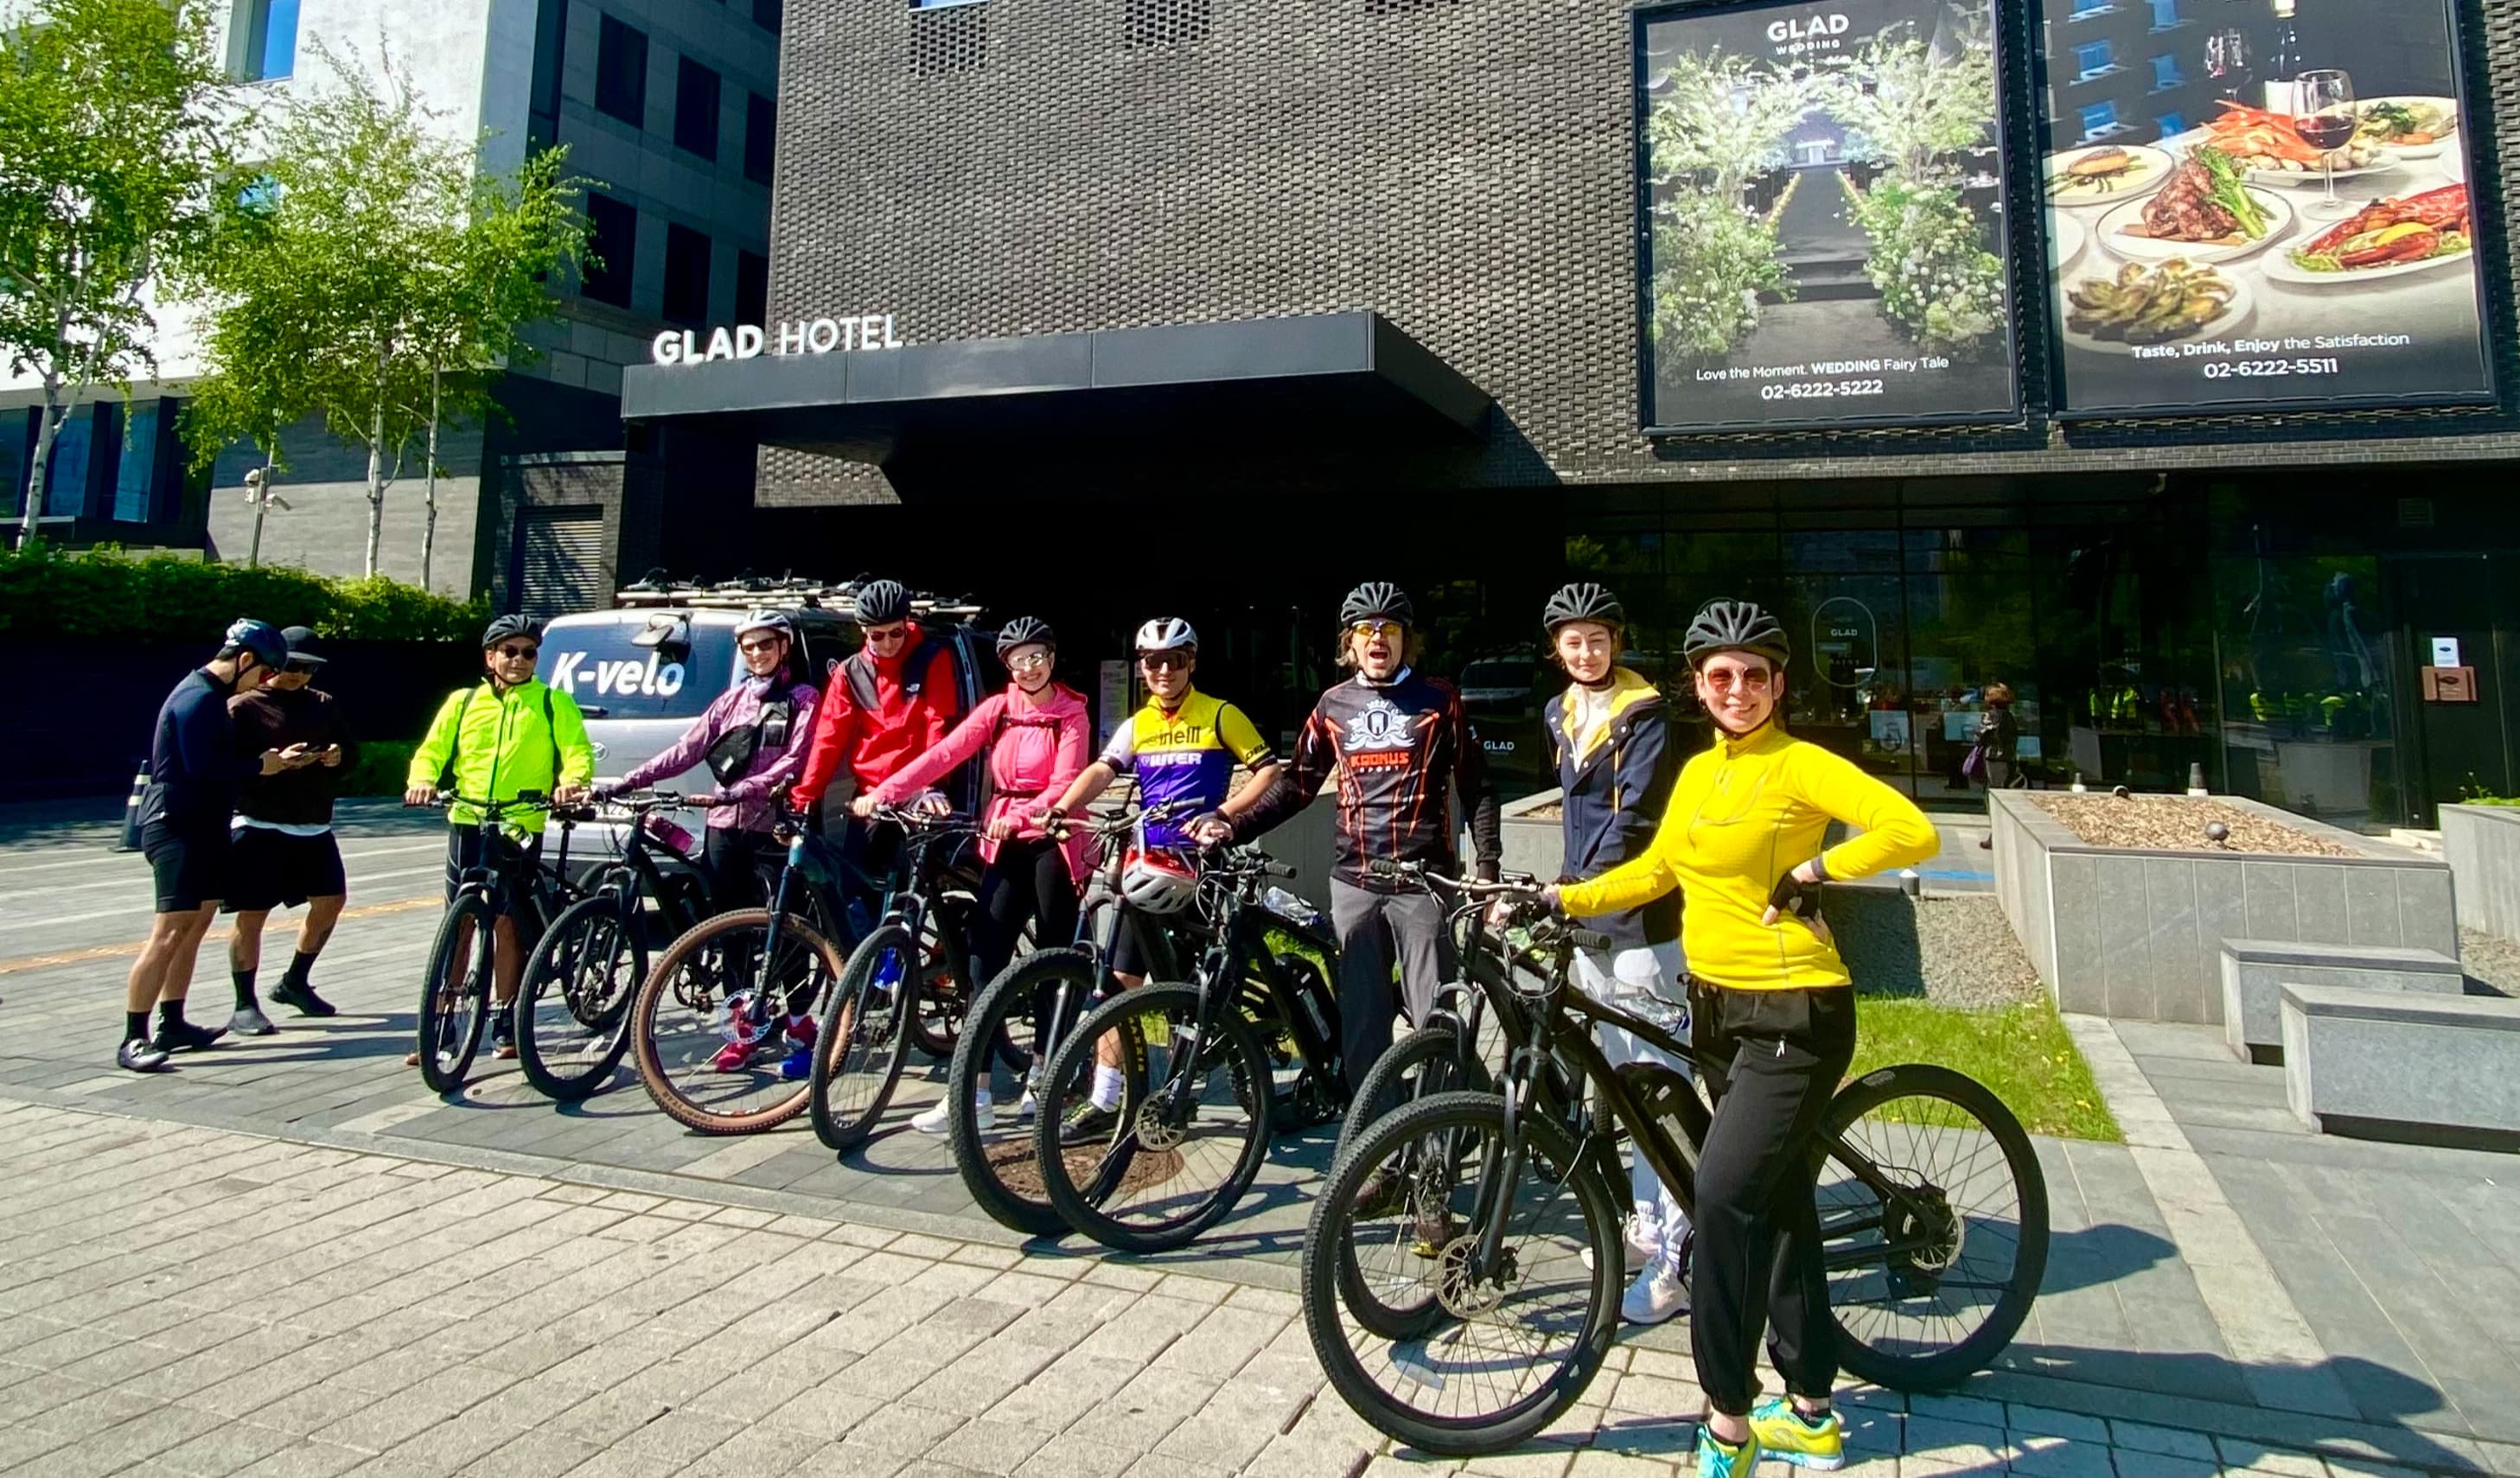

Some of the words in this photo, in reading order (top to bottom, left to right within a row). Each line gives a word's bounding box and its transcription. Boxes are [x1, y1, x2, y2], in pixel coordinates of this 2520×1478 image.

[1767, 14, 1849, 42] GLAD
[1776, 39, 1841, 56] WEDDING
[653, 323, 764, 365] GLAD
[780, 314, 903, 356] HOTEL
[2131, 343, 2180, 359] Taste,
[2184, 340, 2231, 357] Drink,
[2235, 338, 2281, 354] Enjoy
[2284, 336, 2312, 350] the
[2314, 333, 2410, 349] Satisfaction
[1696, 367, 1727, 381] Love
[1730, 366, 1751, 379] the
[1753, 364, 1808, 379] Moment.
[1811, 359, 1881, 375] WEDDING
[1884, 358, 1917, 373] Fairy
[1920, 355, 1950, 369] Tale
[2204, 358, 2338, 379] 02-6222-5511
[1760, 379, 1884, 400] 02-6222-5222
[1830, 628, 1858, 637] GLAD
[549, 651, 686, 697] K-velo
[1483, 740, 1515, 750] GLAD
